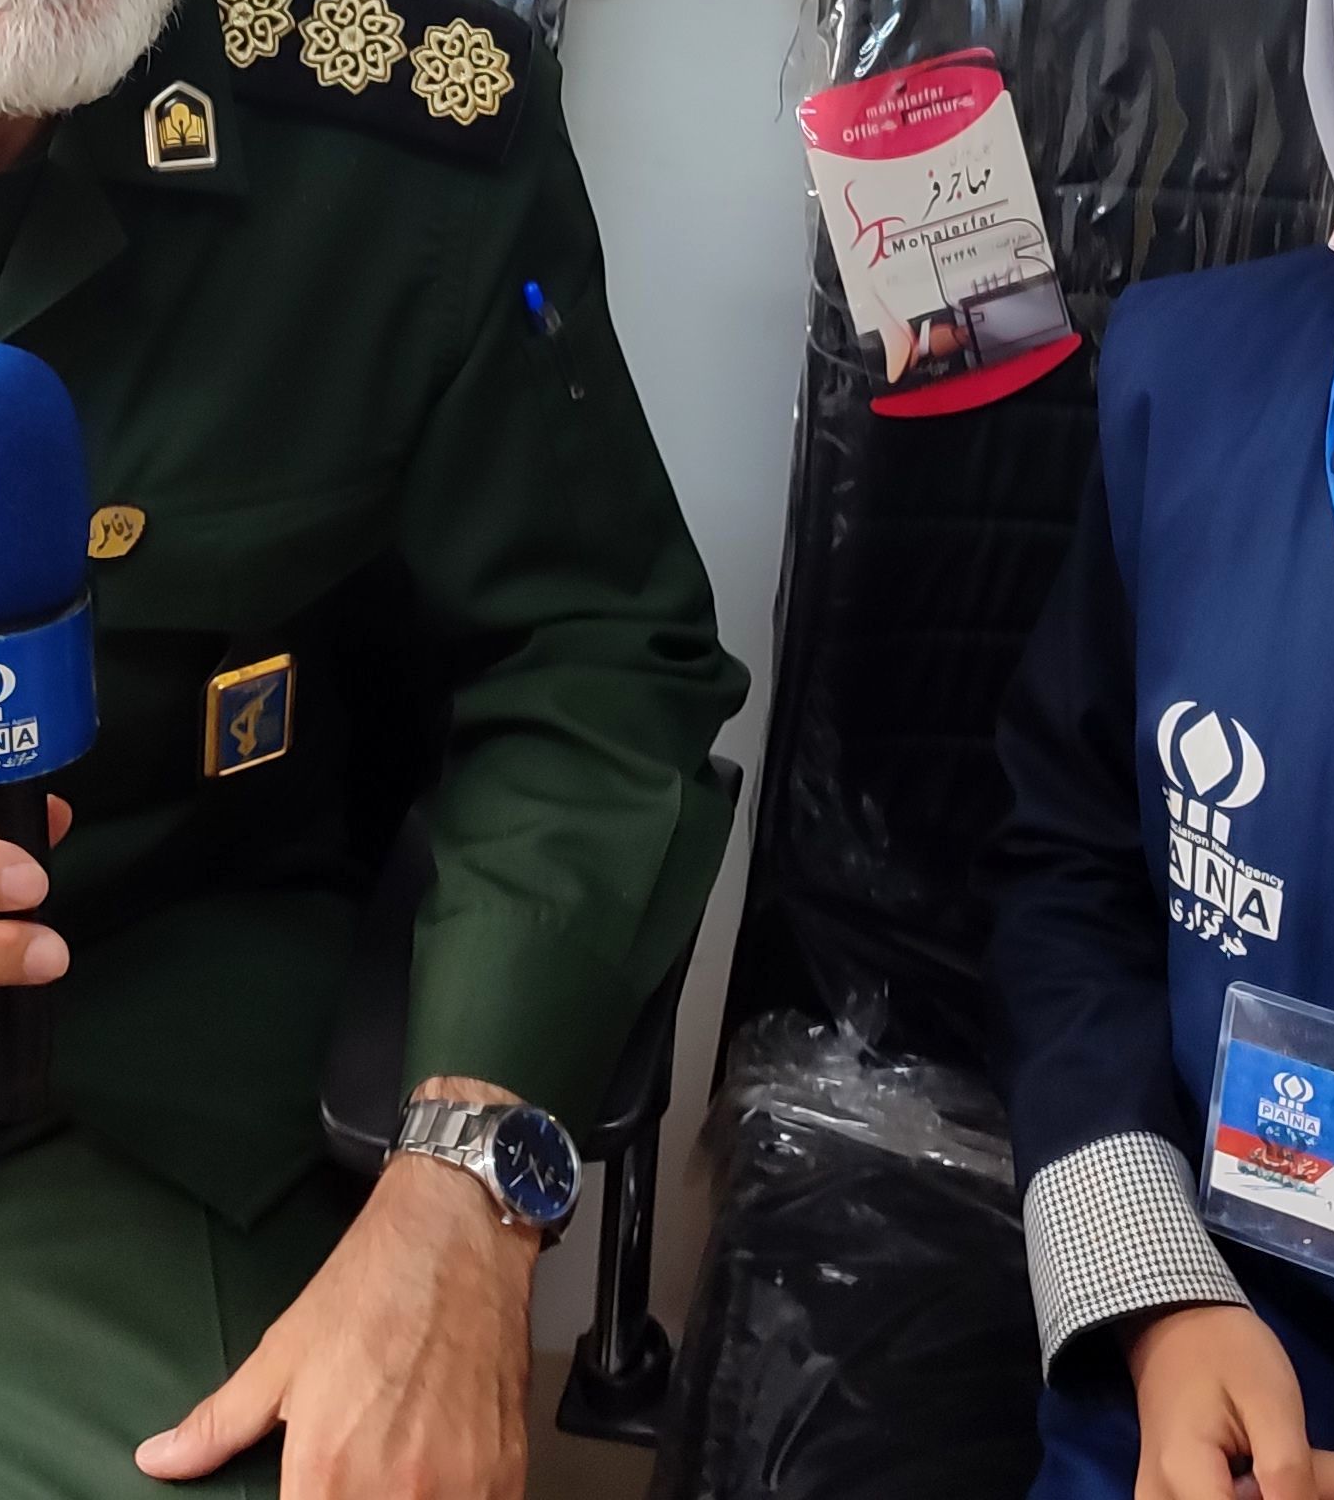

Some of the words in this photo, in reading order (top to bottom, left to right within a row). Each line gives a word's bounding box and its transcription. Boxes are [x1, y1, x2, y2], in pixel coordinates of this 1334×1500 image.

[1169, 835, 1275, 934] ANA
[1236, 858, 1285, 891] Agency
[1260, 1102, 1319, 1135] PANA
